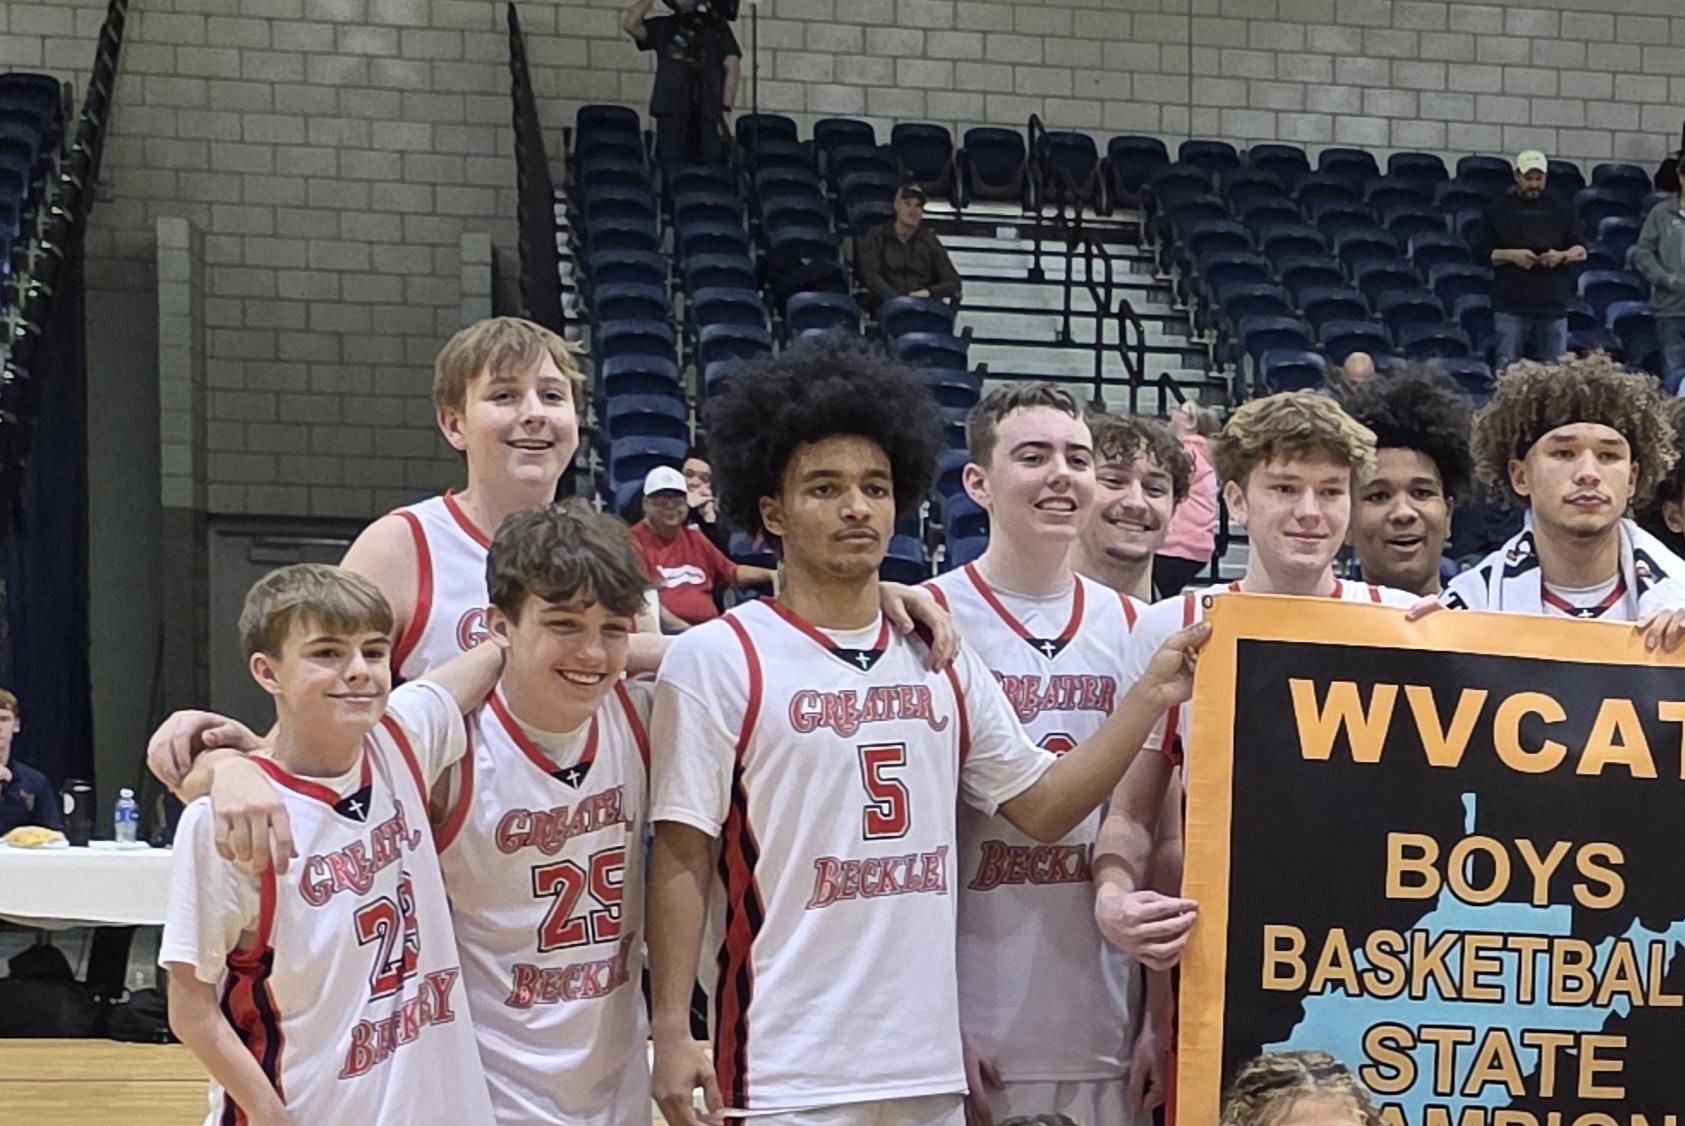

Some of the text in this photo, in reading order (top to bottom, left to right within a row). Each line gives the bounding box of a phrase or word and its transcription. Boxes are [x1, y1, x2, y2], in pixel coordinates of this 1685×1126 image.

[789, 684, 949, 738] GREATER
[991, 669, 1117, 724] REATER
[857, 742, 911, 841] 5
[531, 844, 626, 953] 25
[1385, 832, 1625, 908] BOYS
[1359, 1025, 1628, 1100] STATE
